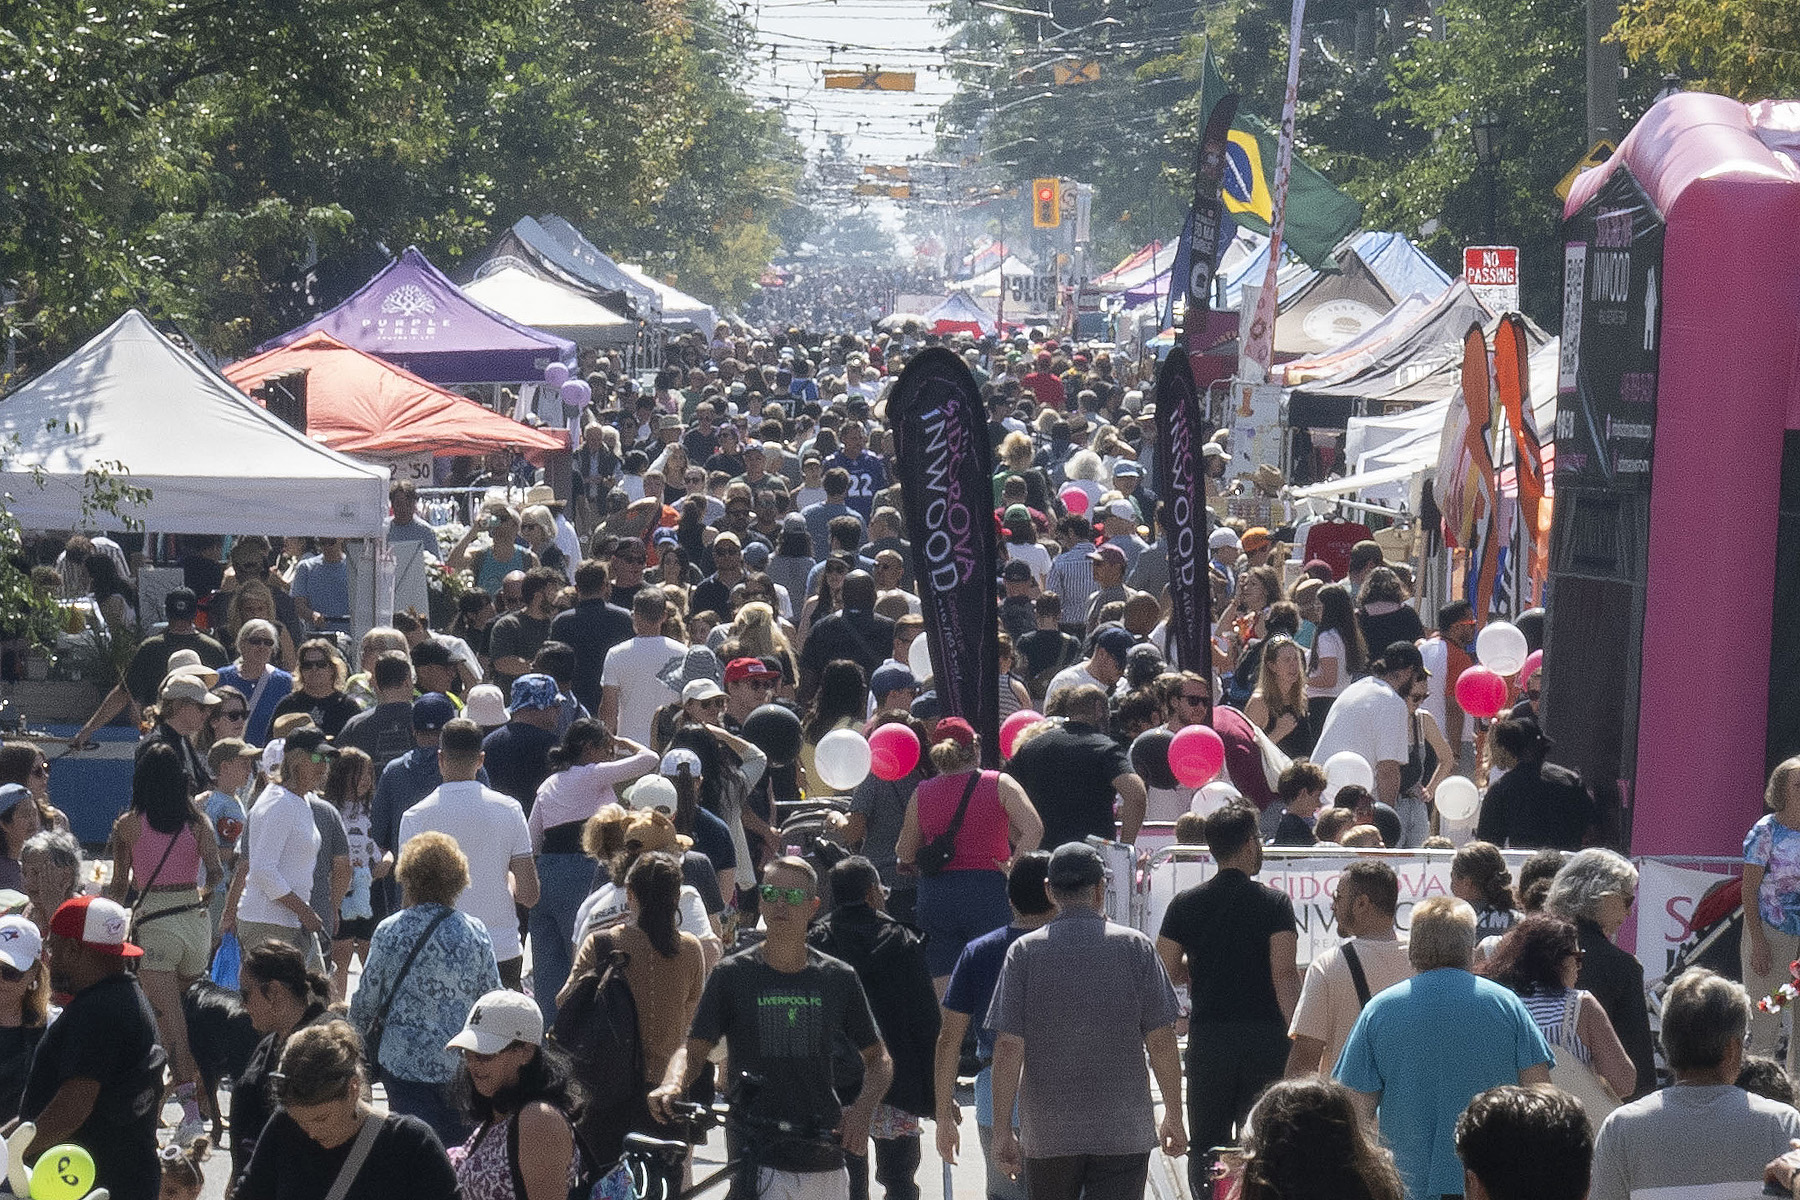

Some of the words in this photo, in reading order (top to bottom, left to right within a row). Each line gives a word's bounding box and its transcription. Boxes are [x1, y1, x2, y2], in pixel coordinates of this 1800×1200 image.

[1483, 251, 1500, 268] NO
[1468, 267, 1514, 284] PASSING
[361, 319, 451, 328] PURPLE
[377, 327, 436, 335] TREE
[847, 473, 873, 497] 22
[921, 407, 959, 592] INWOOD
[1169, 409, 1195, 586] INWOOD
[757, 996, 809, 1007] LIVERPOOL
[810, 997, 822, 1007] FC
